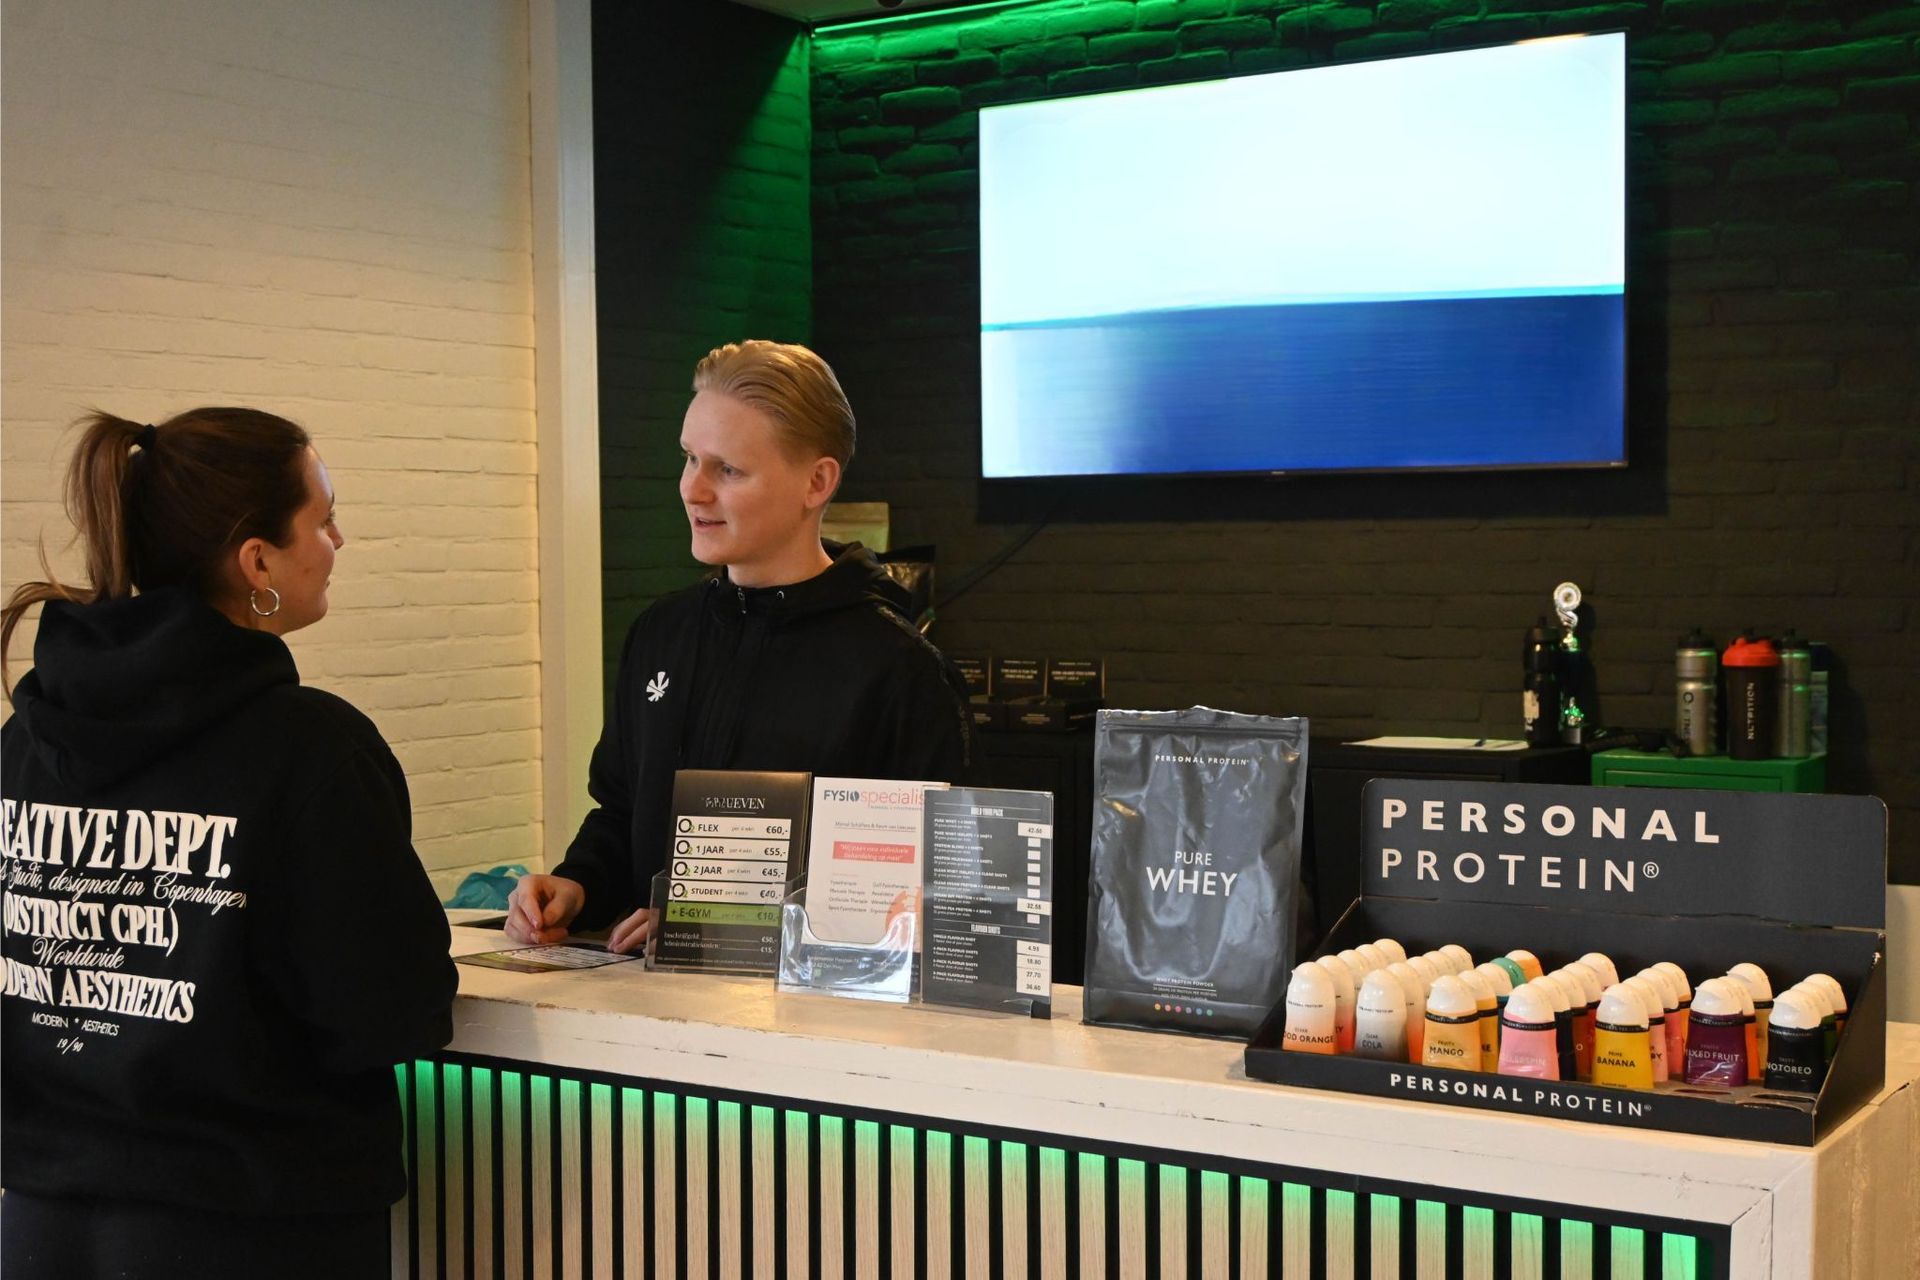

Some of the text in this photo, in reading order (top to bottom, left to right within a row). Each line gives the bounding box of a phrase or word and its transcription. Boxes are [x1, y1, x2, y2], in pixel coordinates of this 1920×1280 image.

[1155, 754, 1204, 764] PERSONAL
[1382, 798, 1720, 843] PERSONAL
[697, 823, 719, 832] FLEX
[766, 825, 788, 835] €60,-
[120, 809, 238, 879] DEPT.
[702, 845, 725, 855] JAAR
[764, 847, 786, 857] €55,-
[1174, 851, 1212, 866] PURE
[693, 865, 698, 874] 2
[700, 866, 722, 875] JAAR
[762, 867, 784, 878] €45,-
[49, 867, 120, 902] designed
[123, 873, 145, 897] in
[1146, 866, 1238, 897] WHEY
[690, 887, 723, 896] STUDENT
[3, 890, 105, 941] (DISTRICT
[680, 907, 712, 918] E-GYM
[32, 936, 125, 969] Worldwide
[60, 968, 196, 1024] AESTHETICS
[32, 1011, 120, 1036] MODERN AESTHETICS
[56, 1036, 84, 1054] 19/90
[1299, 1035, 1335, 1044] ORANGE
[1362, 1040, 1382, 1049] COLA
[1429, 1046, 1464, 1057] MANGO
[1712, 1052, 1740, 1062] FRUIT
[1597, 1056, 1636, 1068] BANANA
[1390, 1073, 1523, 1102] PERSONAL
